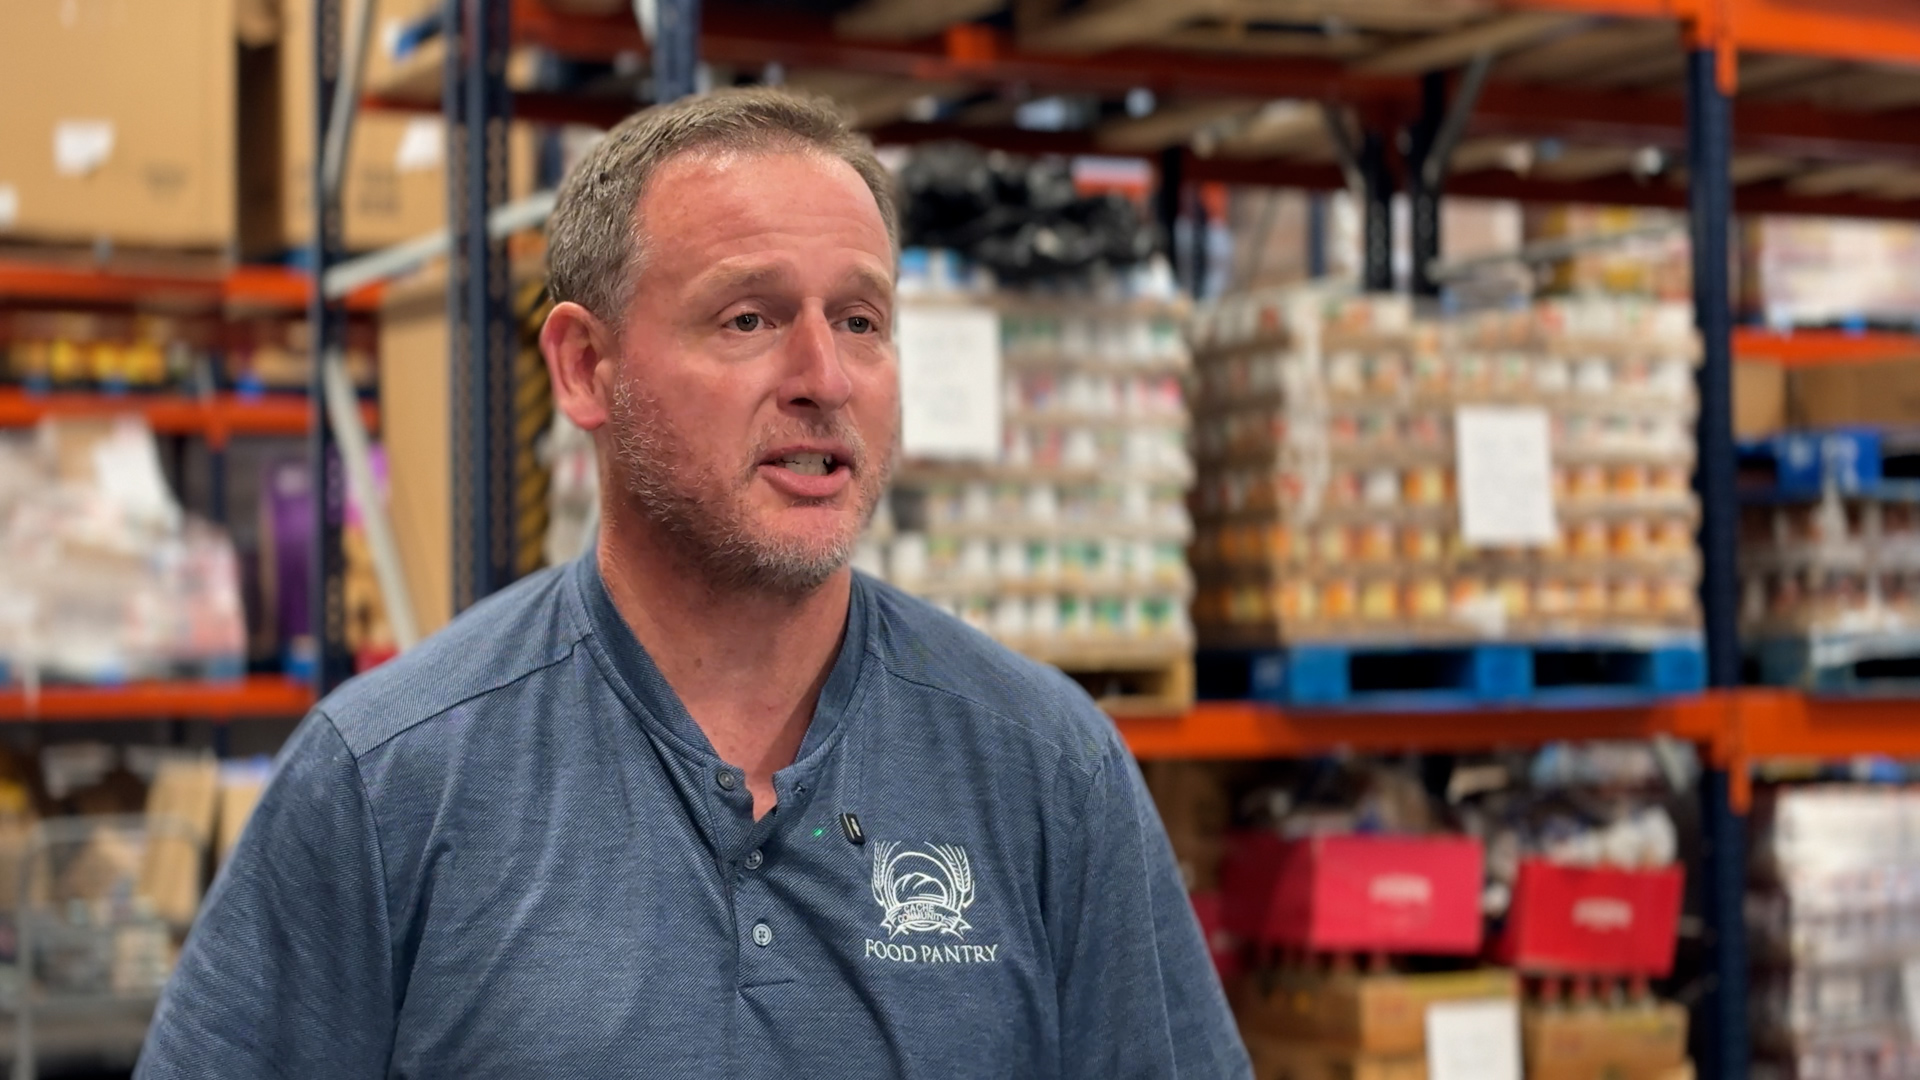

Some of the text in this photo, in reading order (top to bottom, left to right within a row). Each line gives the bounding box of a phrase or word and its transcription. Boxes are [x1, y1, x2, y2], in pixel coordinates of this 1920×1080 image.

[903, 903, 934, 914] CACHE
[898, 912, 945, 923] COMMUNITY
[865, 939, 998, 963] FOOD PANTRY
